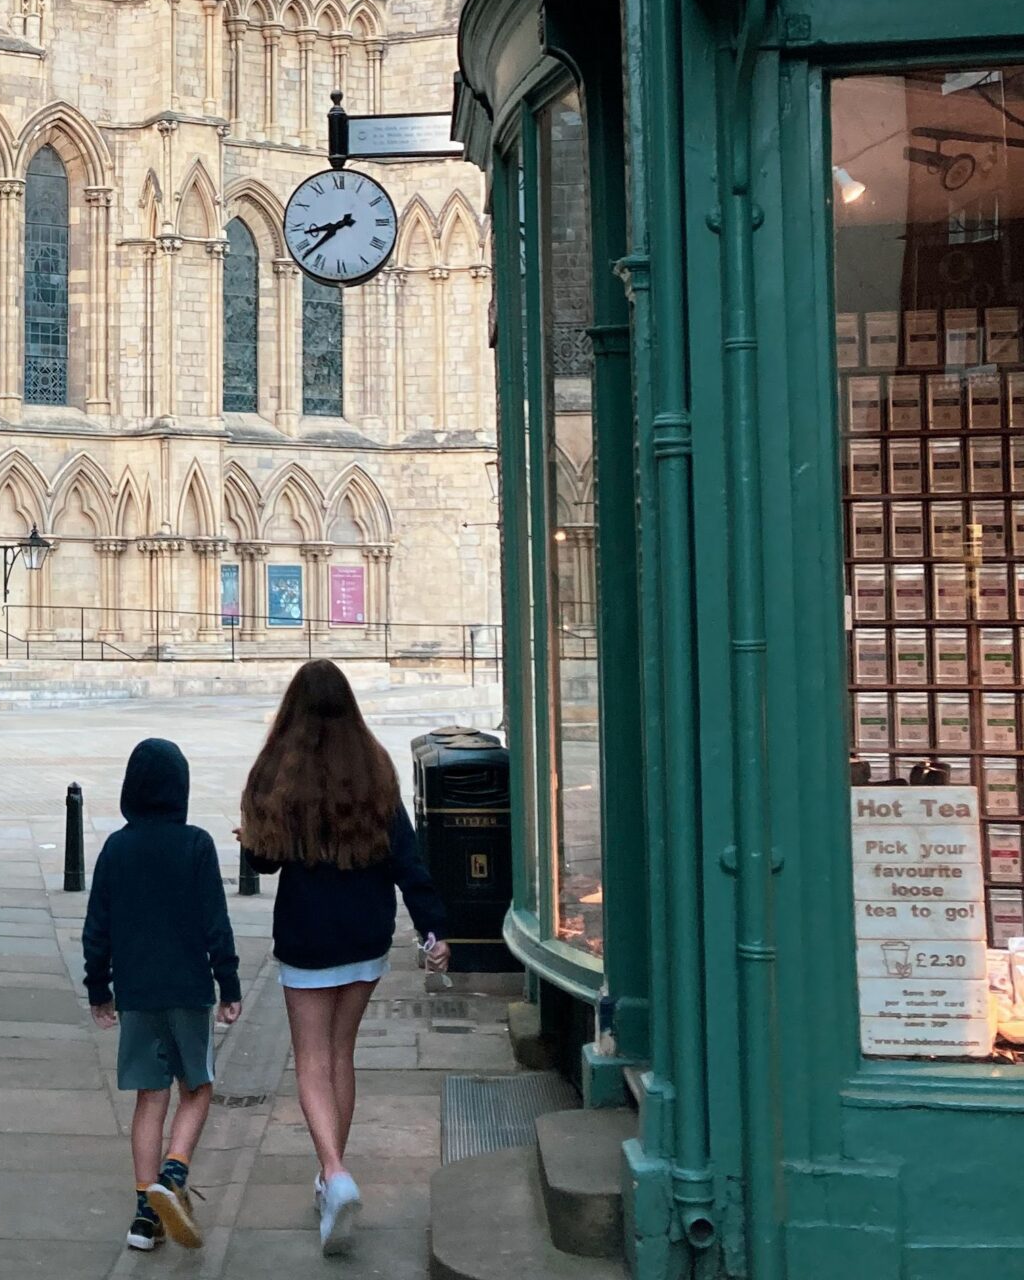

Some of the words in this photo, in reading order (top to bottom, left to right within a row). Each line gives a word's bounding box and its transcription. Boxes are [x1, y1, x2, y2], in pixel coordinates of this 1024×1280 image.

[857, 799, 903, 817] Hot
[920, 799, 971, 817] Tea
[865, 840, 908, 854] Pick
[920, 843, 967, 858] your
[873, 864, 963, 878] favourite
[891, 882, 945, 897] loose
[865, 904, 897, 917] tea
[911, 904, 932, 918] to
[945, 904, 975, 921] go!
